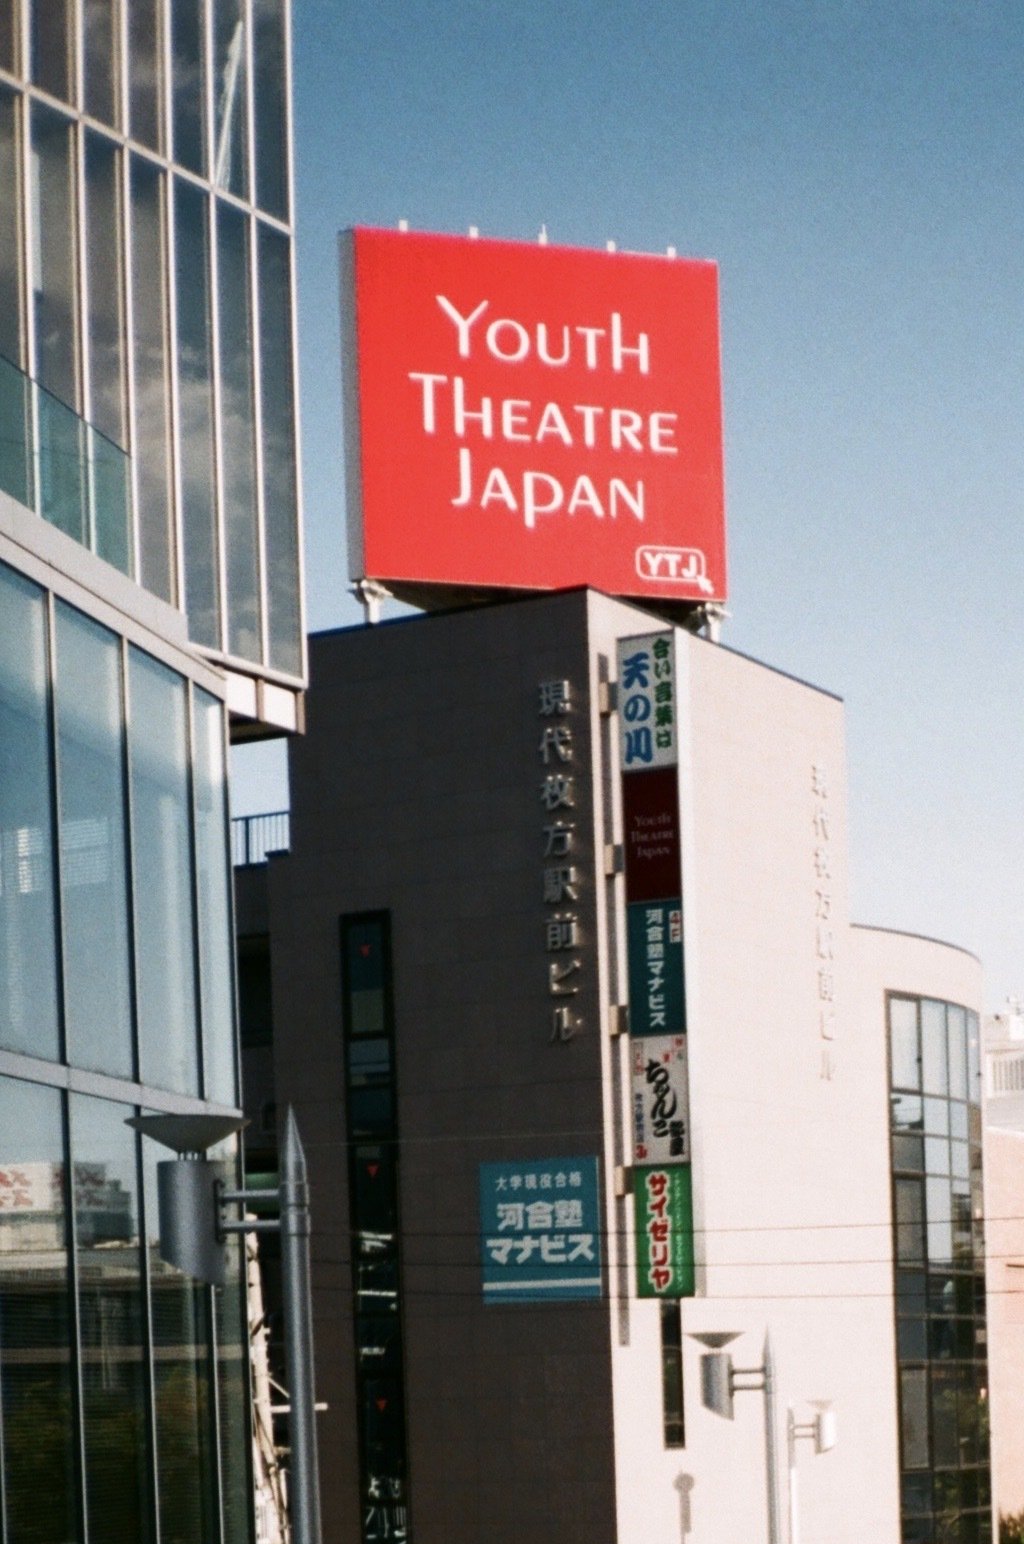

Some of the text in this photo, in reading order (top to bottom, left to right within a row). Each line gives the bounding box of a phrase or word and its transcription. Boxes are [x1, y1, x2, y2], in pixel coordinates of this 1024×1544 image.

[643, 551, 700, 579] YTJ
[623, 651, 653, 764] 天の川
[539, 679, 583, 1041] 現代枚方駅前ビル
[645, 909, 666, 1027] 河合塾マナビス
[645, 1058, 678, 1138] ちゃんこ
[494, 1171, 582, 1192] 大学現役合格
[496, 1199, 583, 1232] 河合塾
[486, 1233, 595, 1265] マナビス
[645, 1170, 673, 1293] サイゼリヤ
